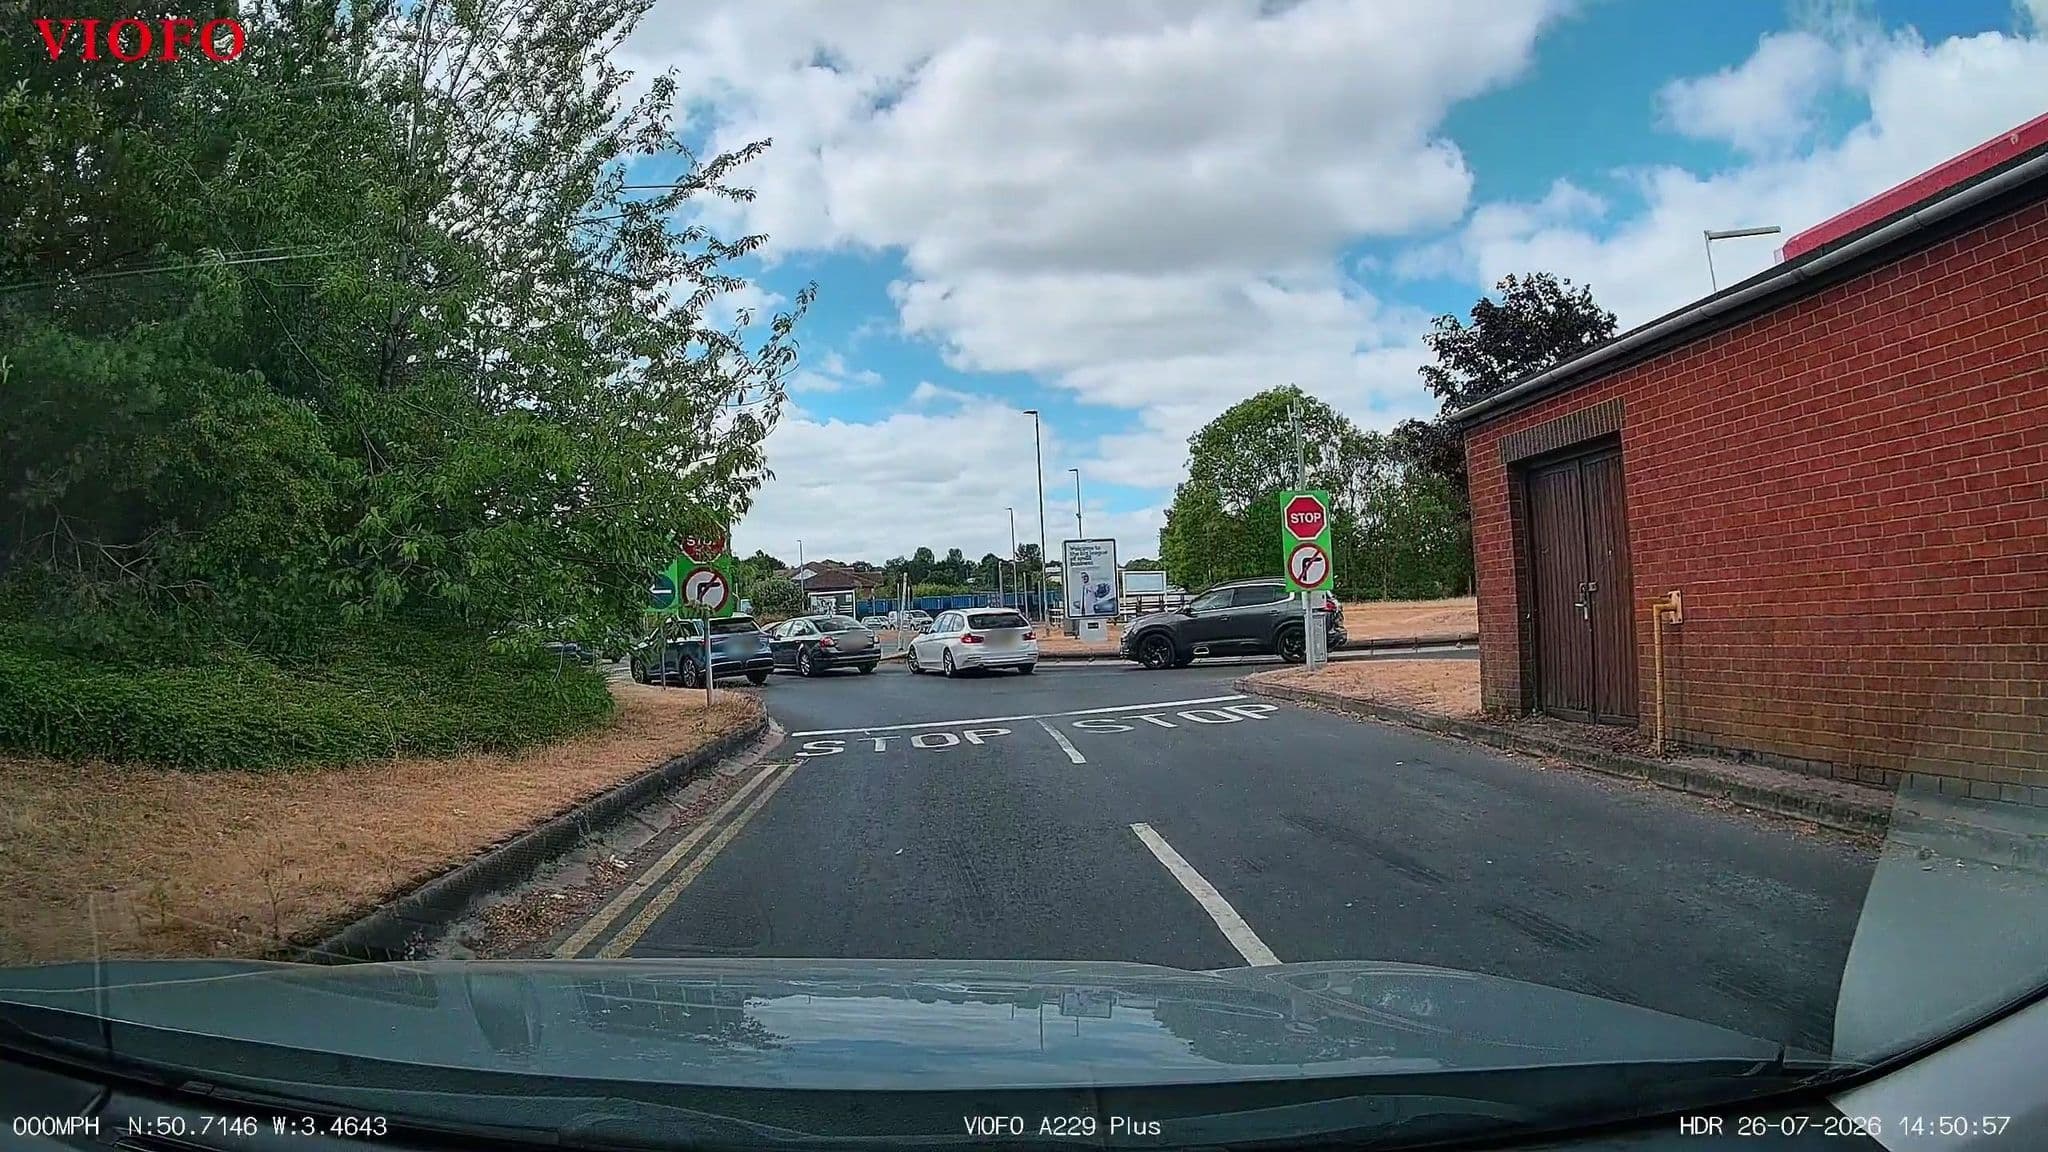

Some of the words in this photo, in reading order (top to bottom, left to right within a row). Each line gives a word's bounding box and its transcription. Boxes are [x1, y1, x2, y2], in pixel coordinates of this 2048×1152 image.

[1290, 512, 1321, 524] STOP
[1072, 704, 1280, 734] STOP
[794, 727, 1013, 758] STOP
